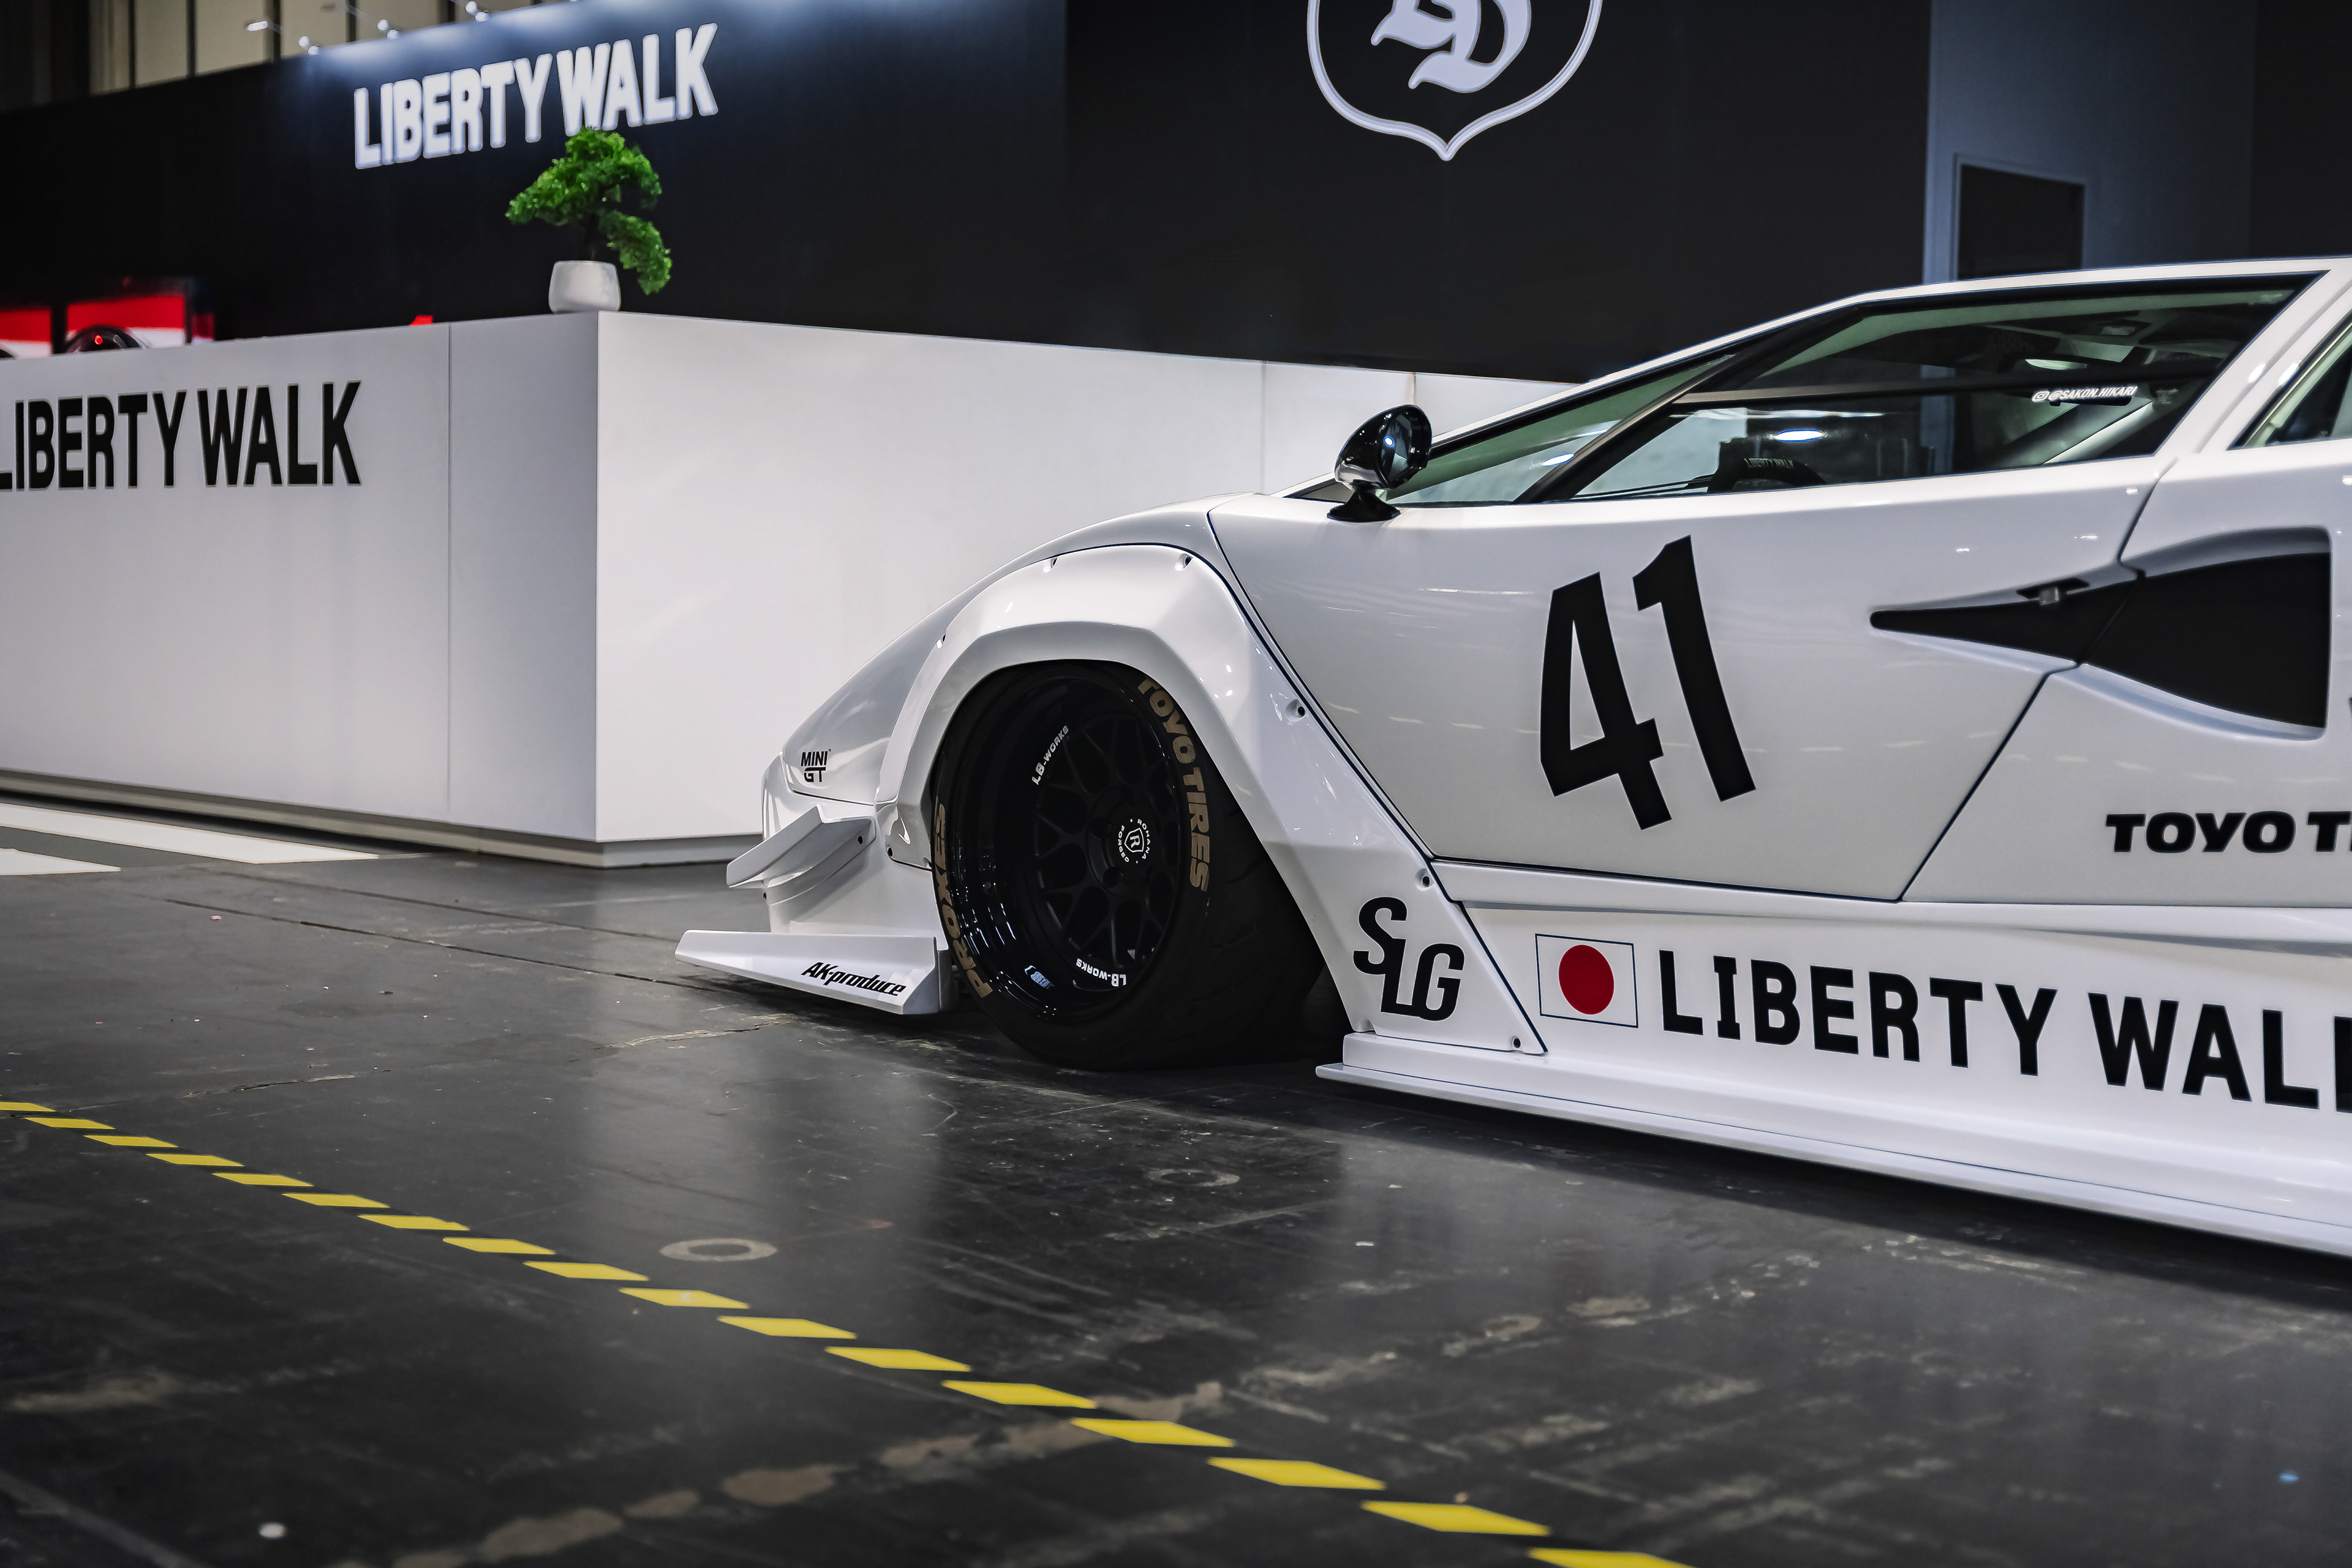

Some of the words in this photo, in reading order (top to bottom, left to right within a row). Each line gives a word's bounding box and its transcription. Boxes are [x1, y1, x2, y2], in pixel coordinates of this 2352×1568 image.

[354, 53, 552, 169] LIBERTY
[556, 23, 718, 137] WALK
[197, 380, 361, 487] WALK
[1540, 535, 1757, 831] 41
[801, 750, 828, 766] MINI
[804, 767, 826, 782] GT
[1031, 725, 1069, 785] LB-WORKS
[1137, 675, 1196, 764] TOYO
[1183, 767, 1210, 892] TIRES
[1137, 819, 1151, 859] ROMANA
[2106, 811, 2296, 853] TOYO
[801, 960, 907, 997] AK-produce
[1076, 958, 1126, 987] LB-WORKS
[1352, 896, 1464, 1022] SLG
[1659, 950, 2058, 1077] LIBERTY
